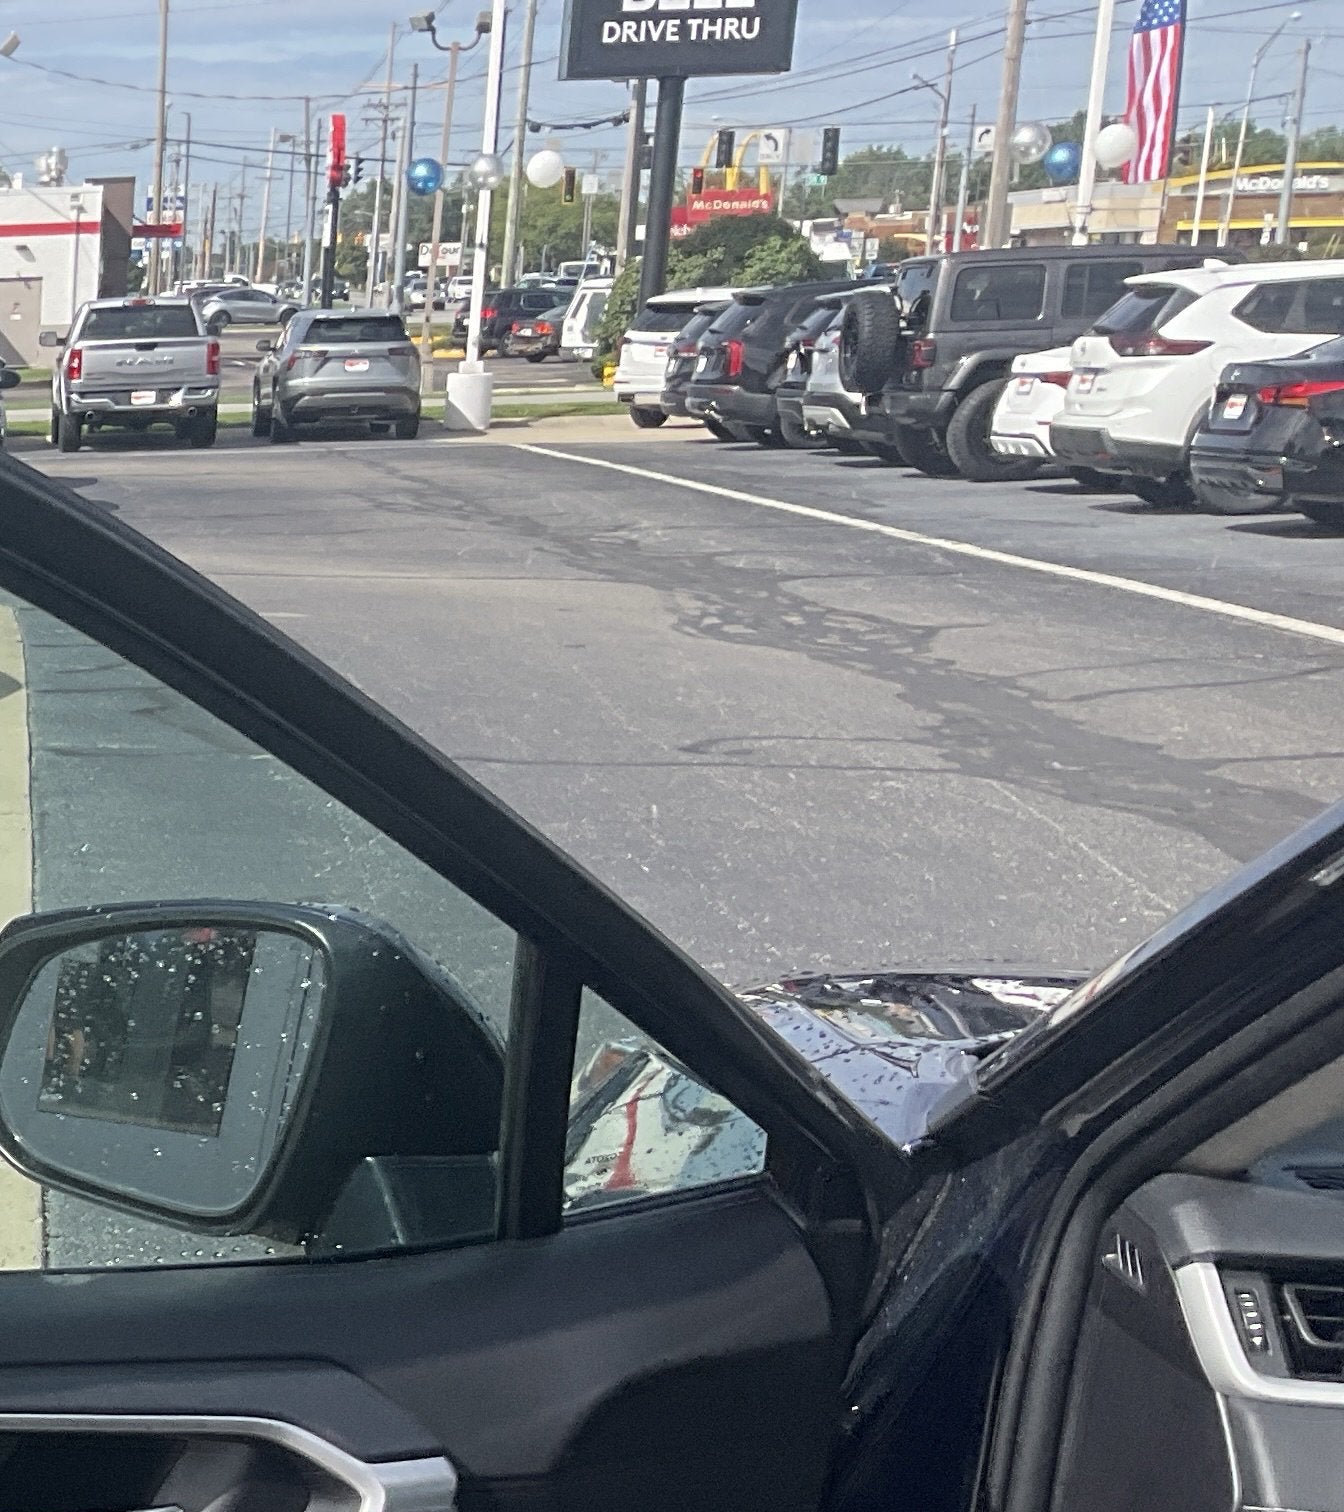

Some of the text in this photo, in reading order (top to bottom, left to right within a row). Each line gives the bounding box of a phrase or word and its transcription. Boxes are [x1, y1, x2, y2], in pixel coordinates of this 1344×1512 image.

[602, 17, 761, 43] DRIVE THRU
[1236, 175, 1329, 190] McDoald's
[692, 199, 769, 211] McDonald's
